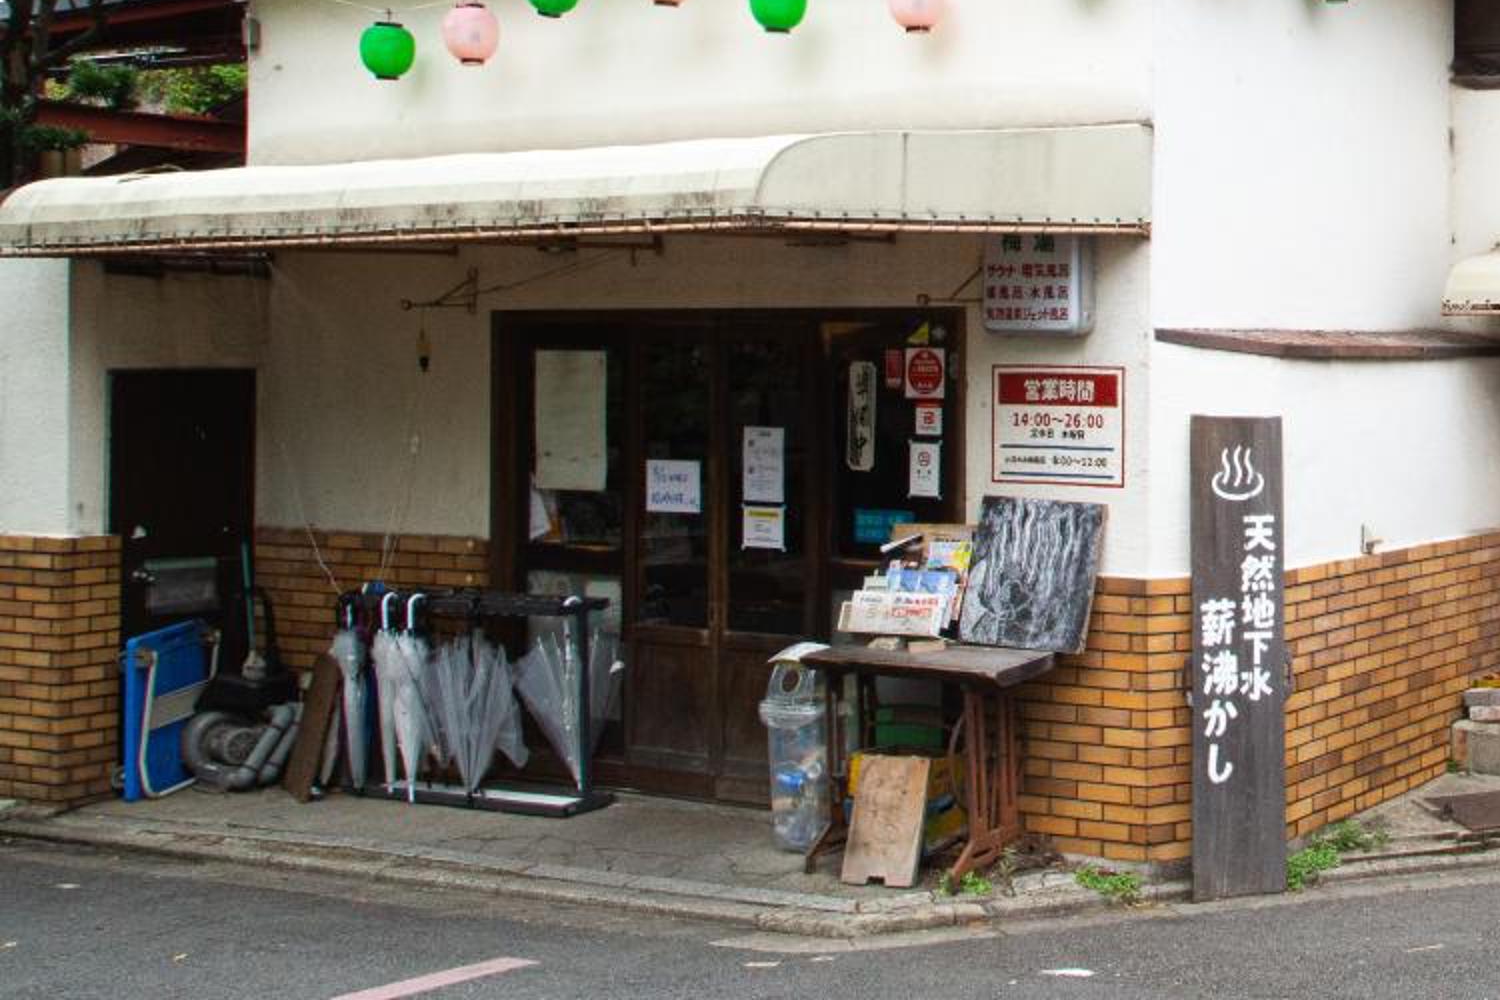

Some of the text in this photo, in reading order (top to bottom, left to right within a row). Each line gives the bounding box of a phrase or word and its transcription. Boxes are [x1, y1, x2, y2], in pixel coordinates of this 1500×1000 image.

[1023, 378, 1095, 403] 営業時間
[1200, 598, 1238, 785] 薪沸かし
[1240, 515, 1275, 702] 天然地下水
